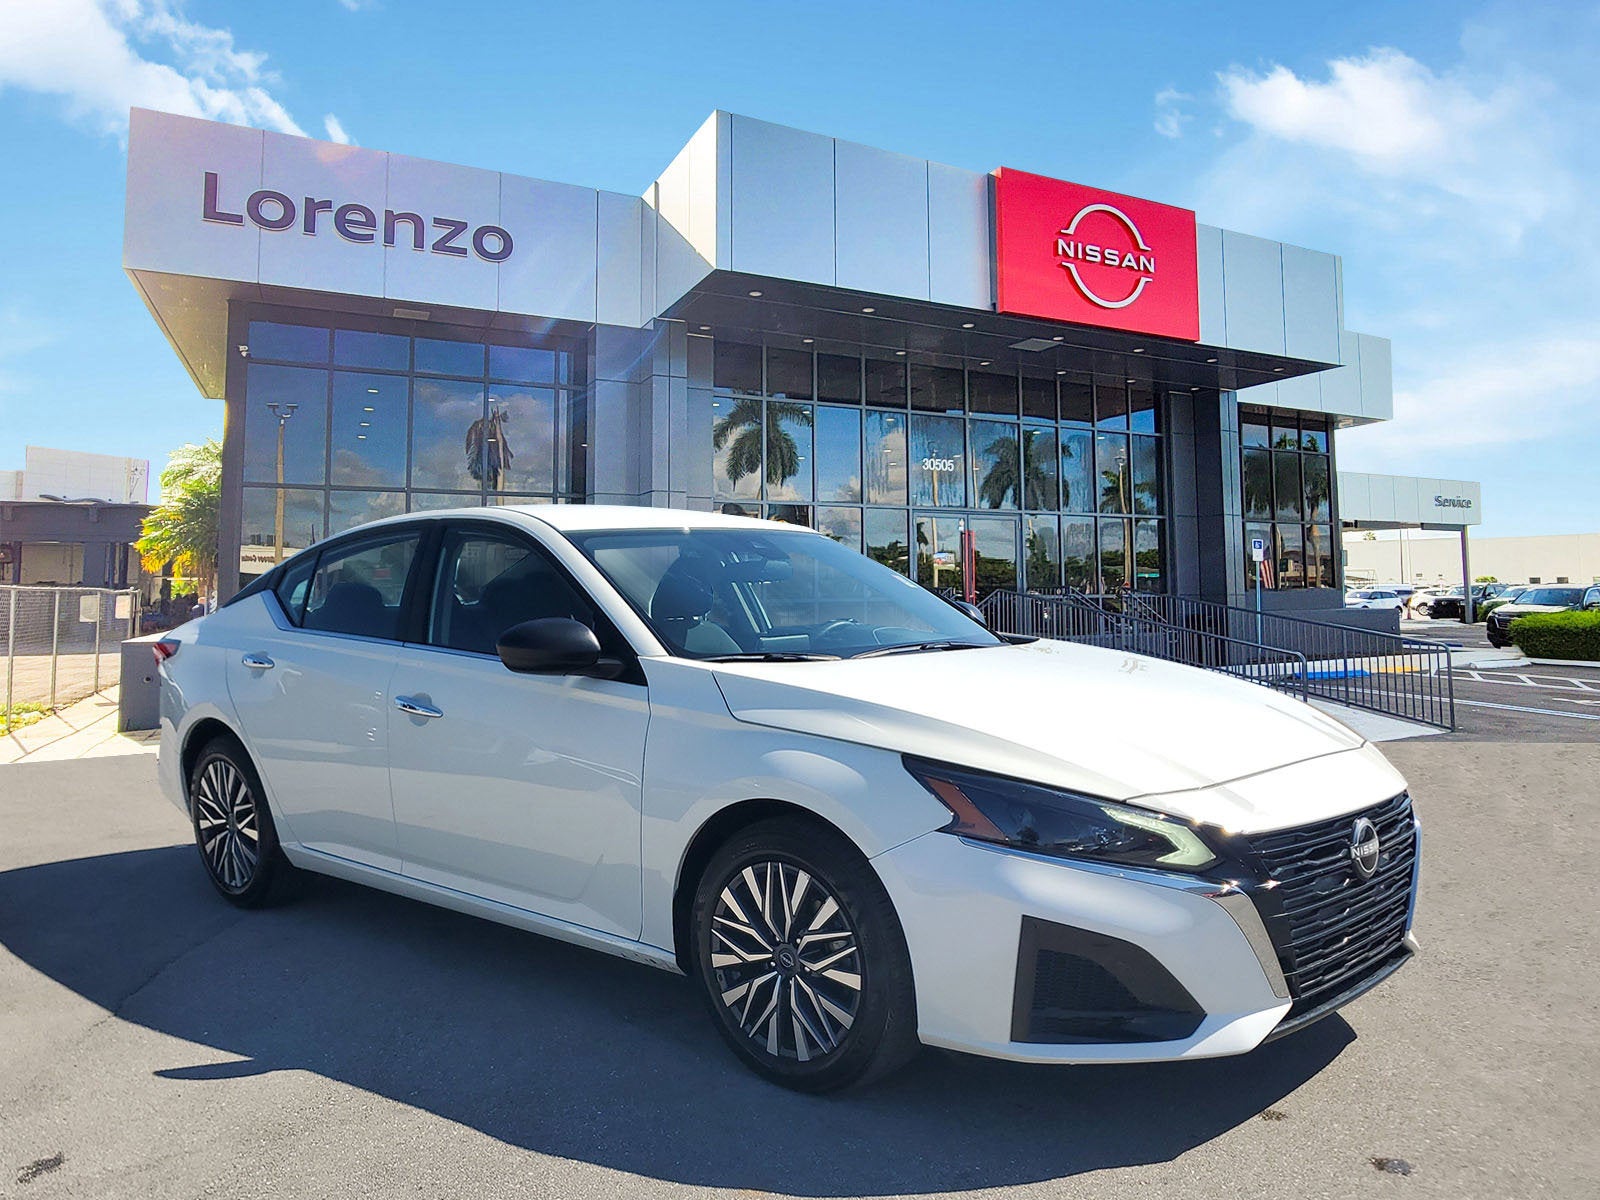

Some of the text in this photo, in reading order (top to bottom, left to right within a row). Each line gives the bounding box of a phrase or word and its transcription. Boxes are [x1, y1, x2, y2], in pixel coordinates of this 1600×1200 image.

[202, 170, 514, 262] Lorenzo
[1057, 238, 1155, 273] NISSAN
[922, 458, 955, 471] 30505
[1434, 495, 1472, 508] Service
[1351, 841, 1378, 859] NISS
